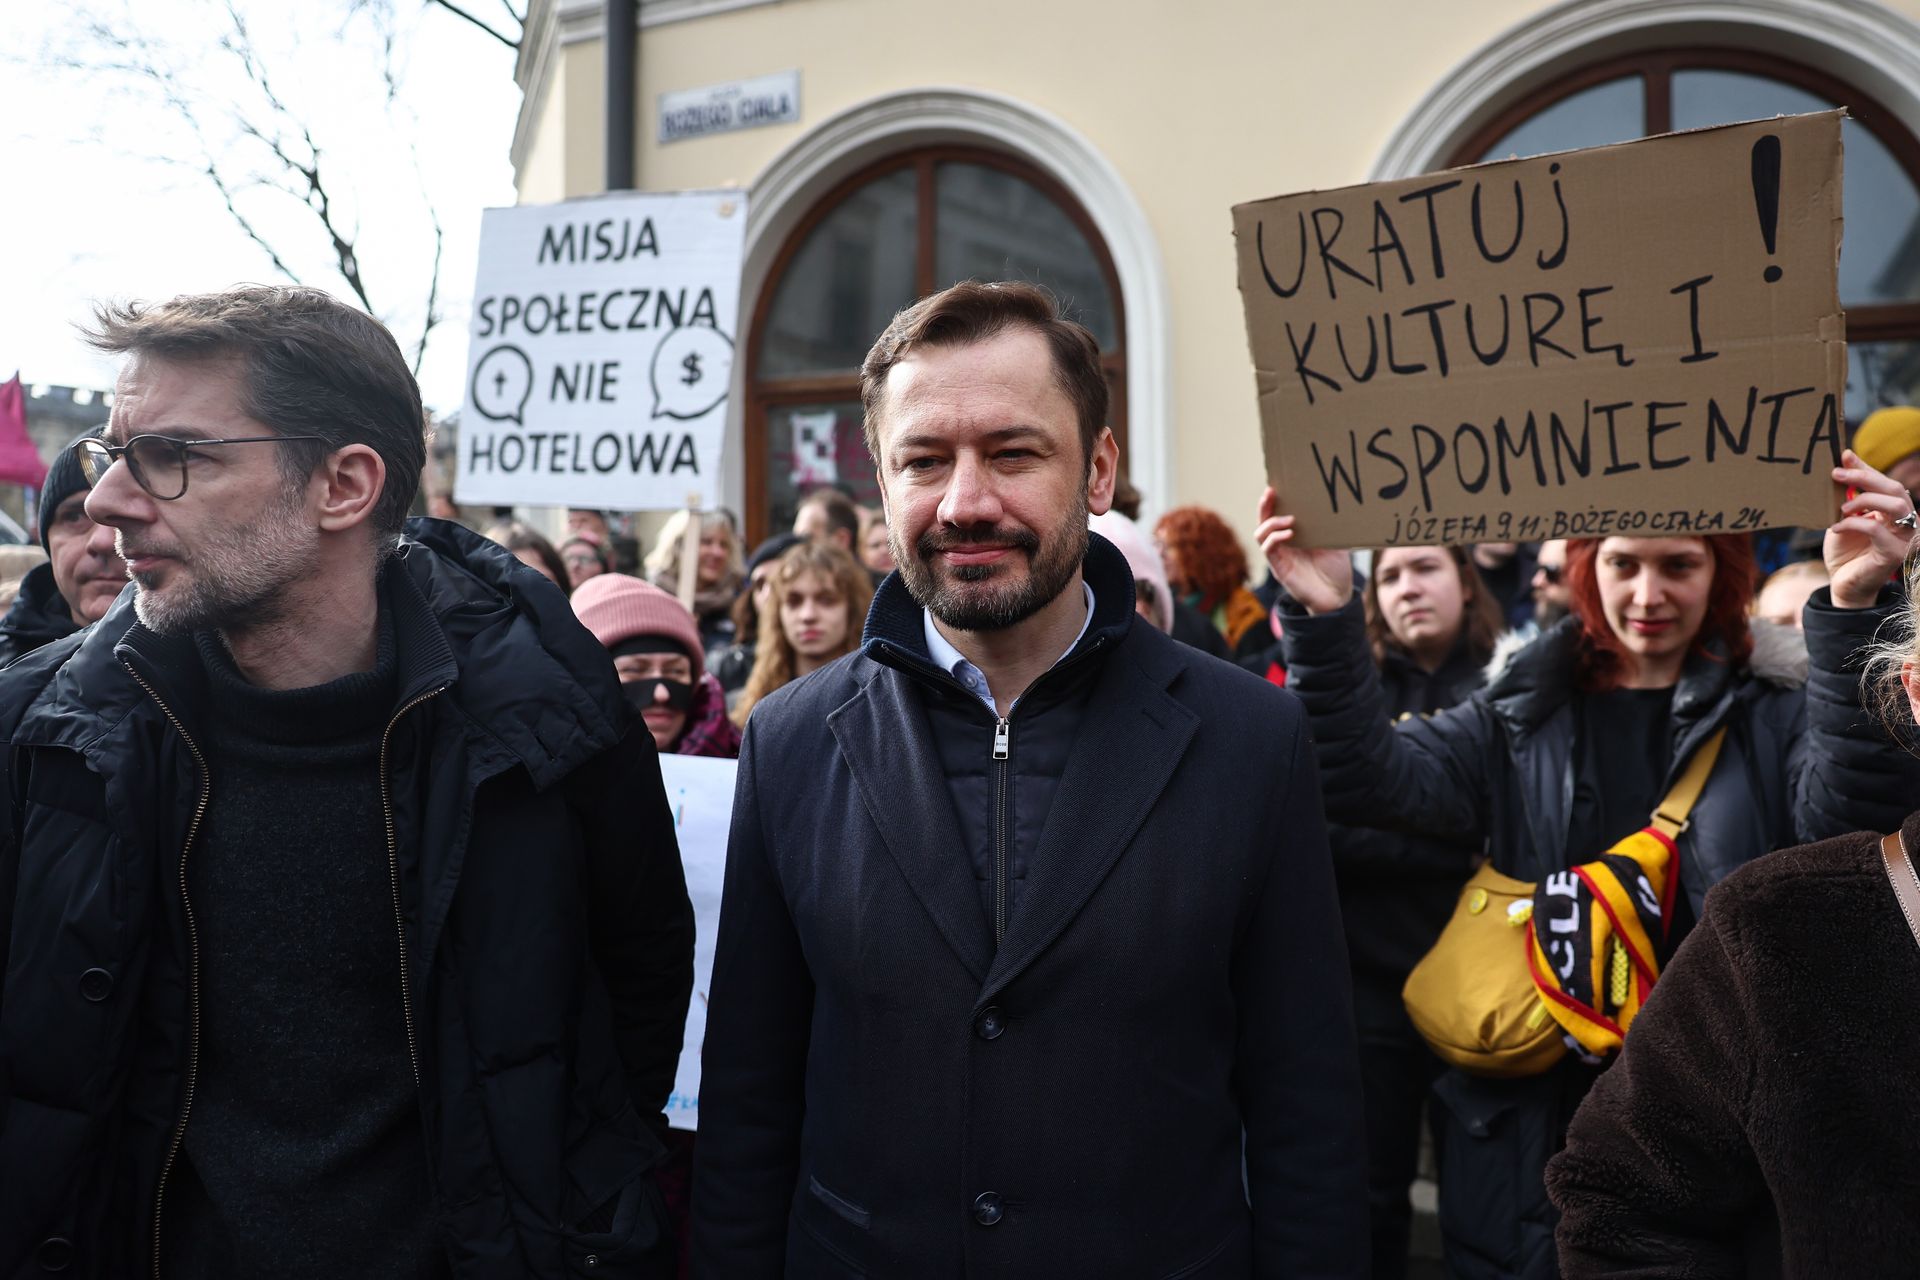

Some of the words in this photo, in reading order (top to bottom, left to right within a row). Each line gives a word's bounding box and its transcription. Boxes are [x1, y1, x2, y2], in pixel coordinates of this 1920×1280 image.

[537, 216, 660, 265] MISJA
[477, 287, 719, 338] SPOŁECZNA
[1286, 286, 1635, 404] KULTURĘ
[1671, 275, 1719, 363] I
[550, 361, 621, 402] NIE
[468, 433, 700, 475] HOTELOWA
[1311, 386, 1841, 513] WSPOMNIENIA
